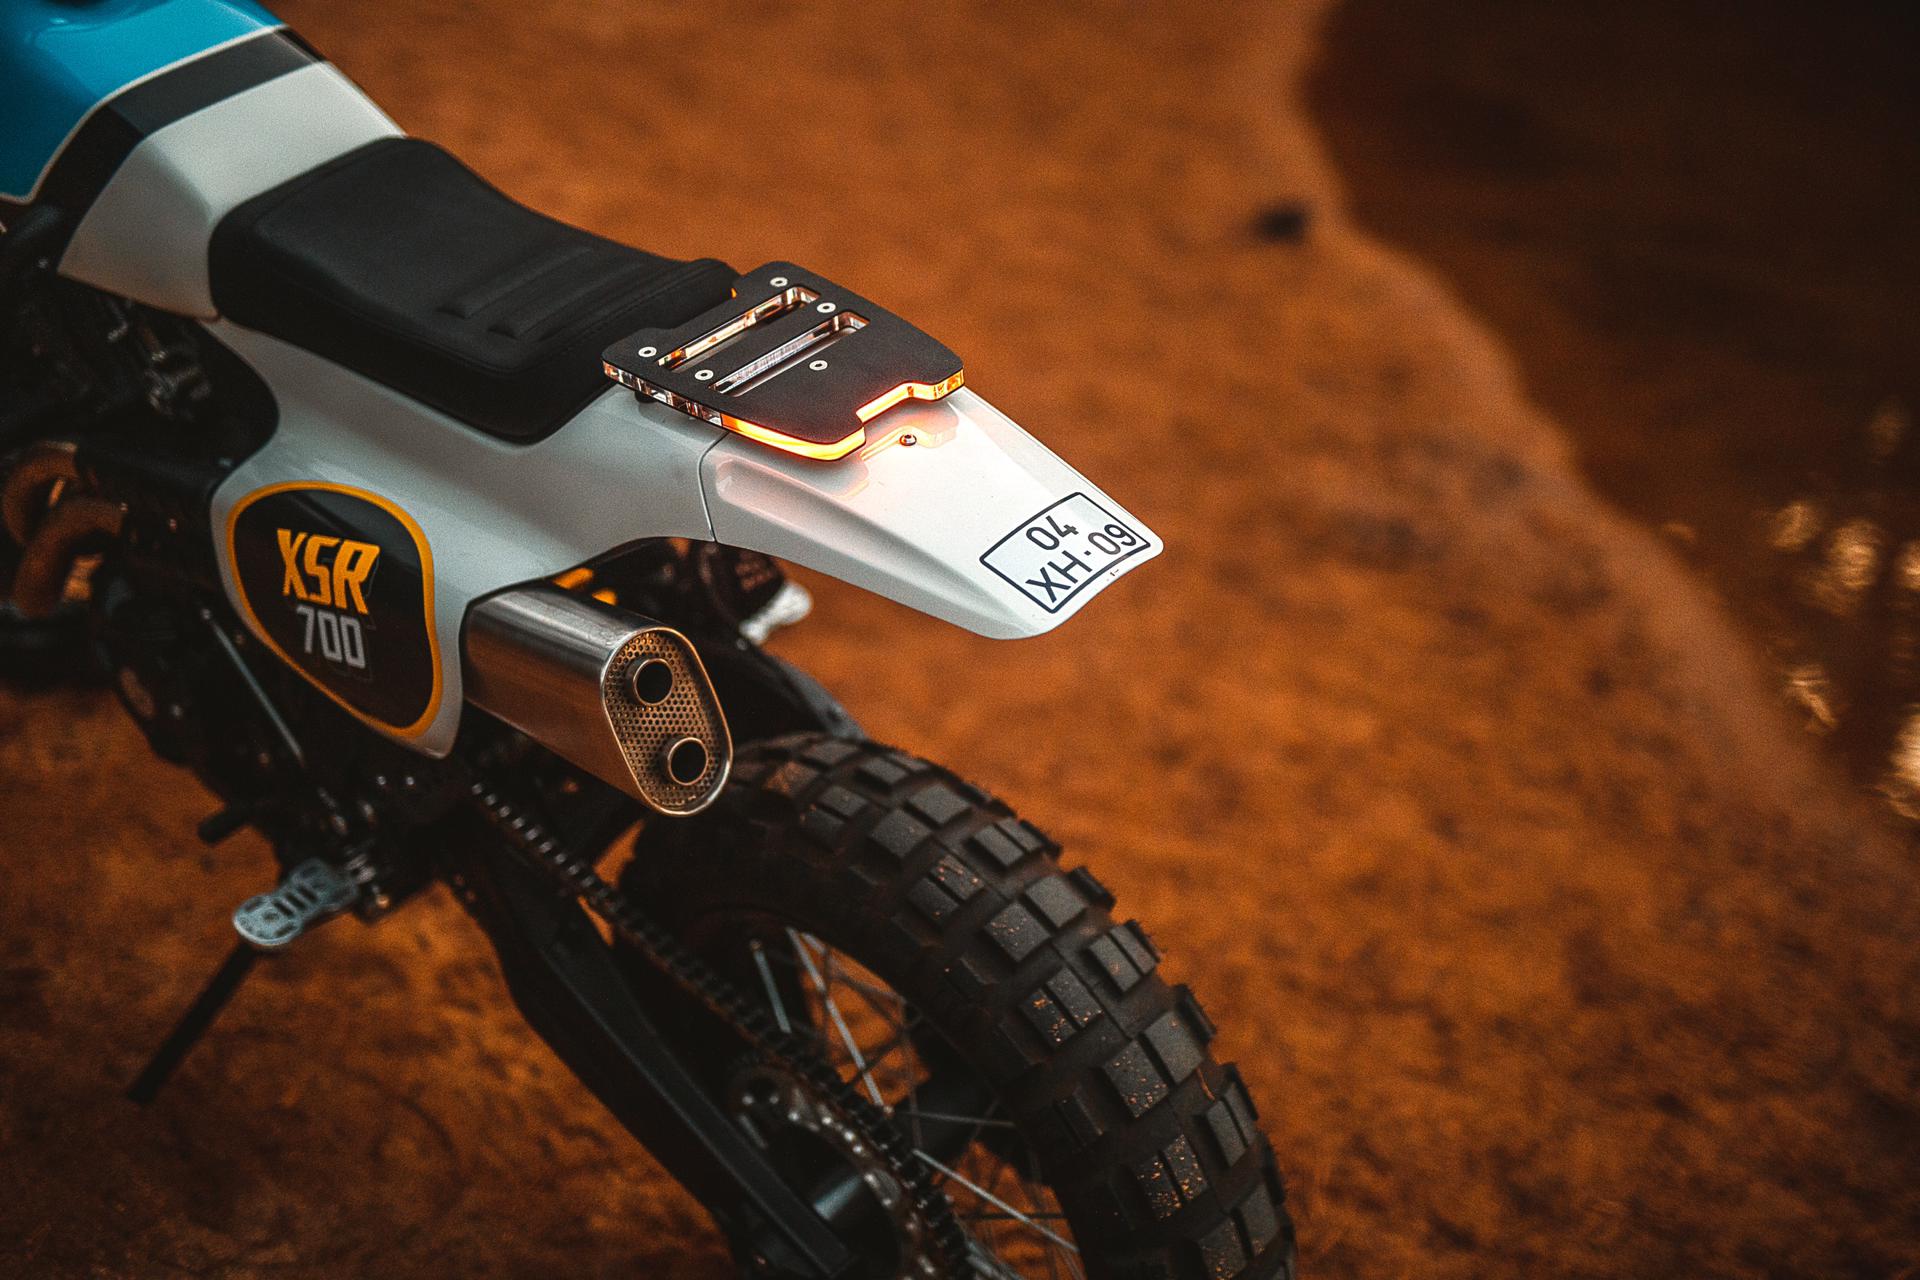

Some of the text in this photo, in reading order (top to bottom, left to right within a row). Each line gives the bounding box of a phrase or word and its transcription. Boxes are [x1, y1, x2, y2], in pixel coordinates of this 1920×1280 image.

[1026, 515, 1079, 550] 04
[277, 528, 380, 615] XSR
[296, 604, 366, 669] 700
